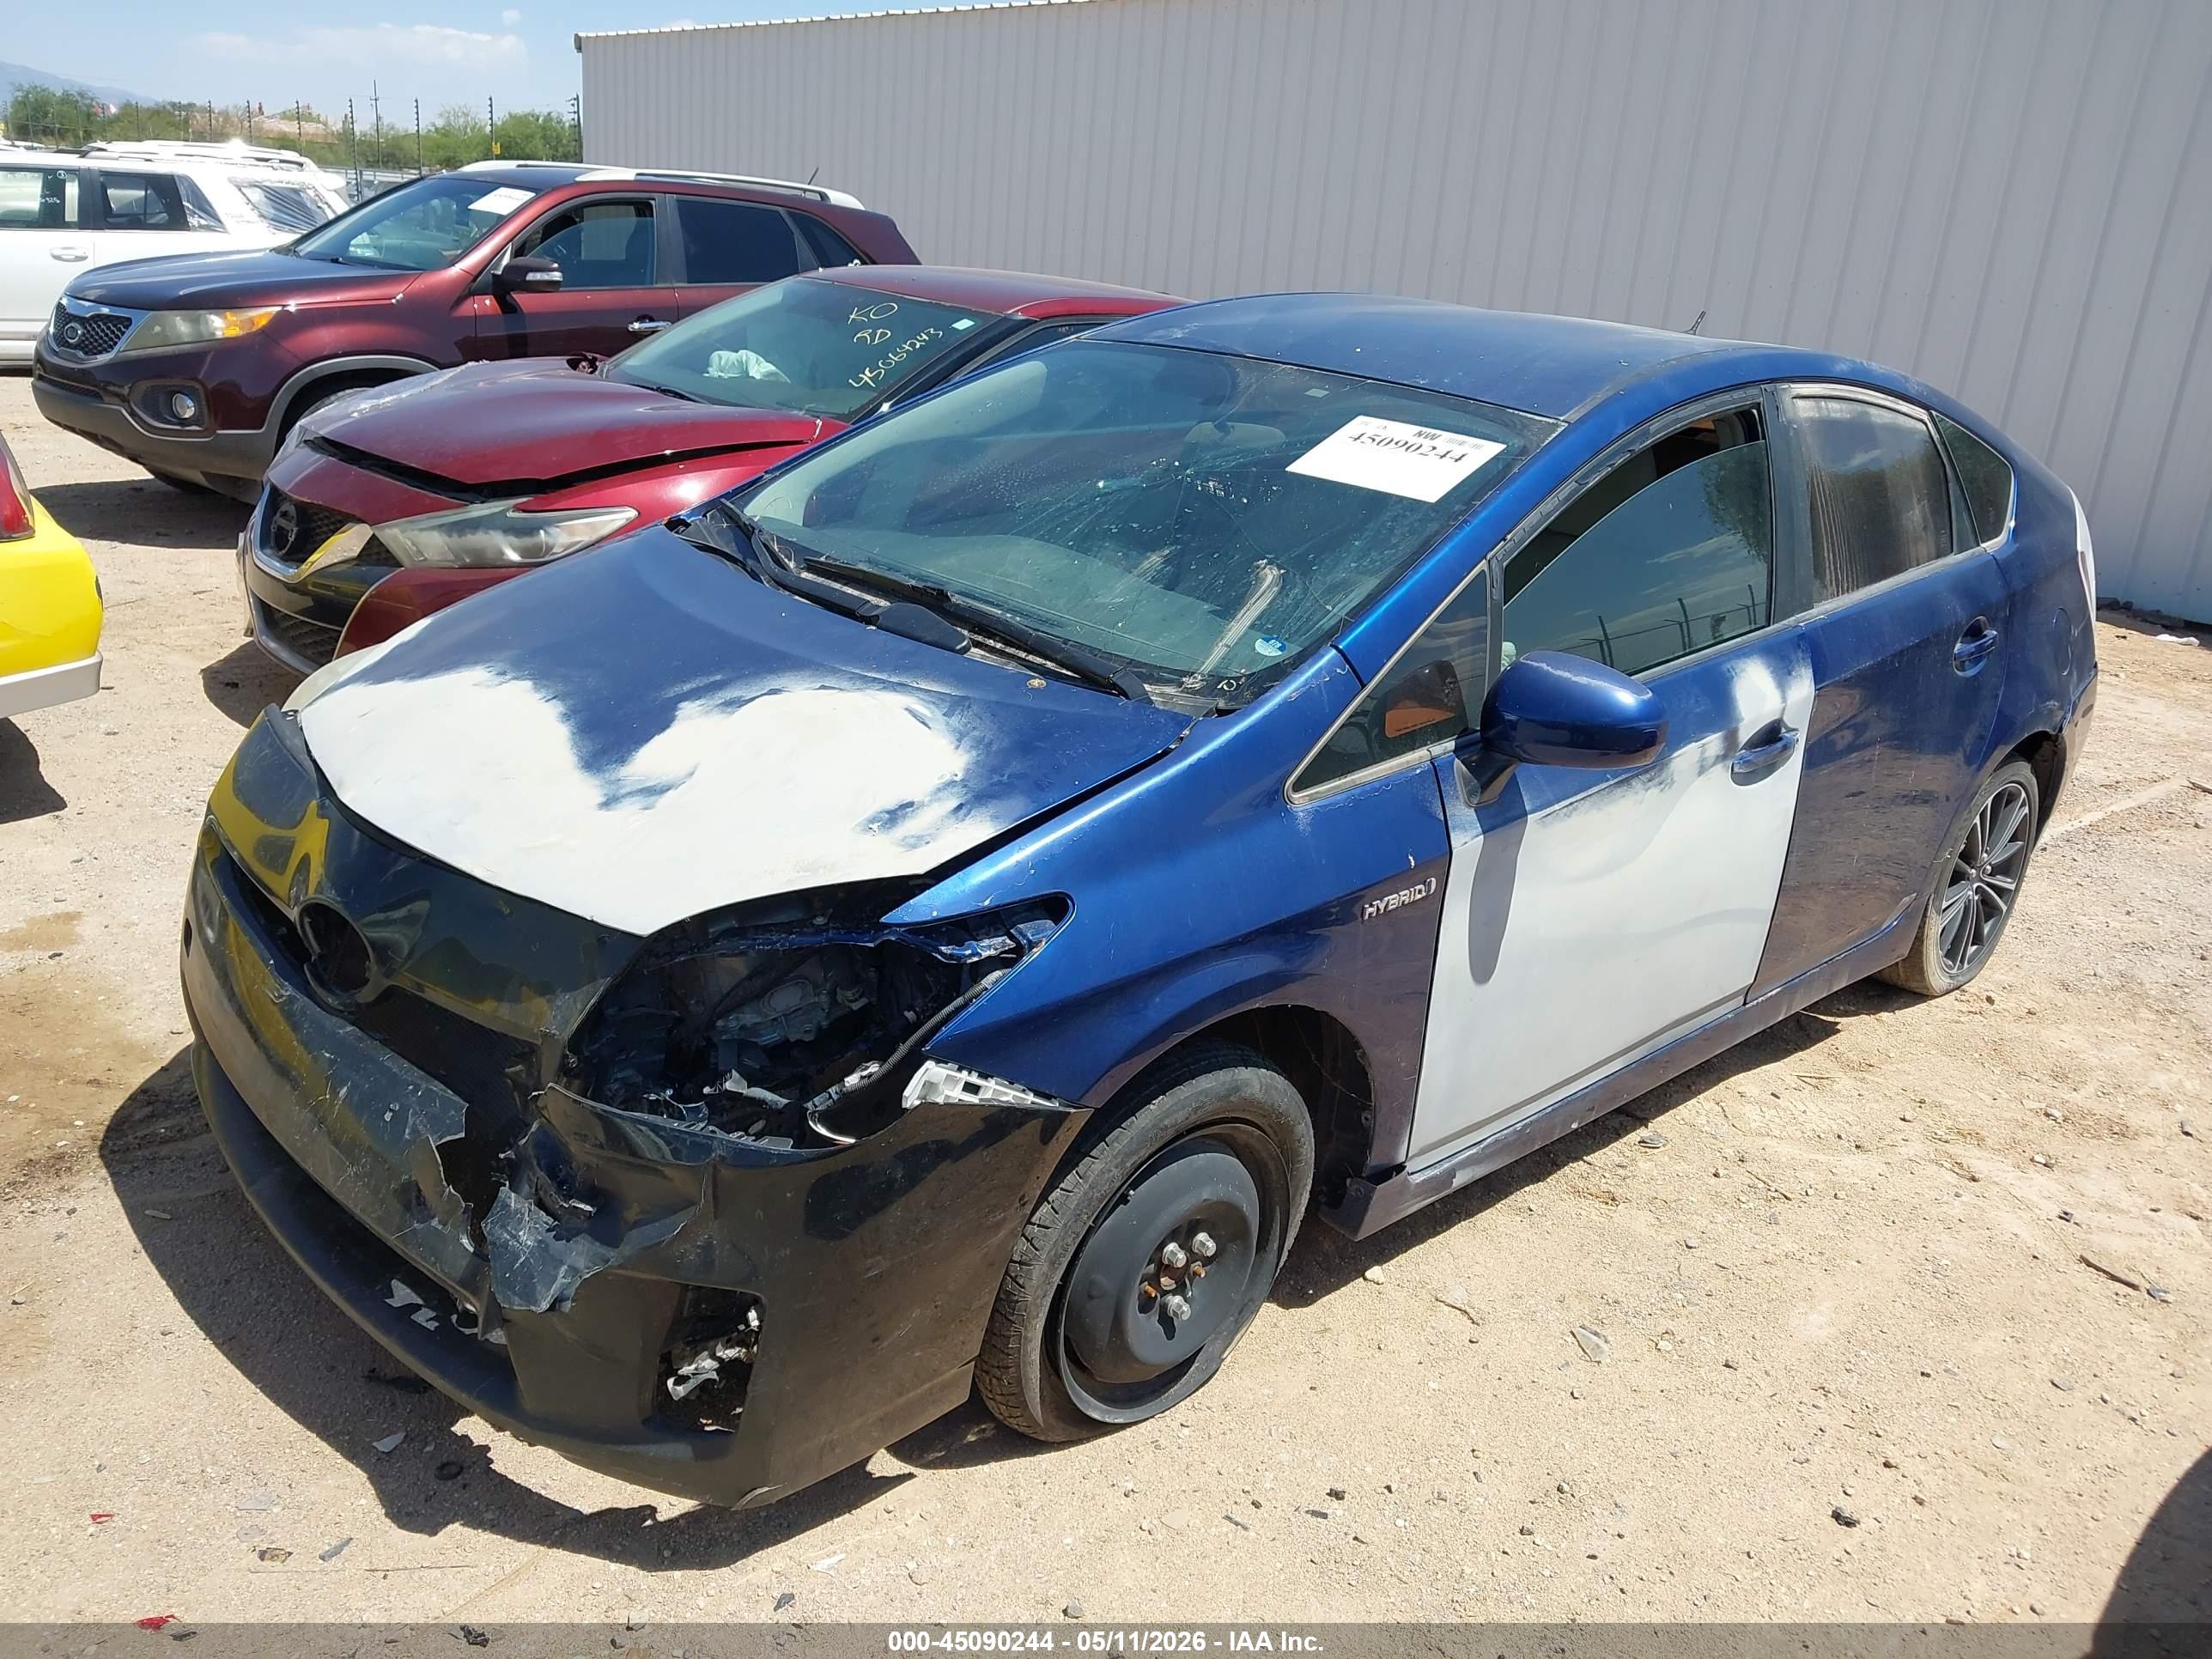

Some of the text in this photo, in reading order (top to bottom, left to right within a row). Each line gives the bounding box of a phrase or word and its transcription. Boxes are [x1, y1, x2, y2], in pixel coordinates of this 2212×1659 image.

[848, 327, 943, 387] 45064243
[1348, 432, 1469, 463] 45090244
[1363, 884, 1427, 921] HYBRID
